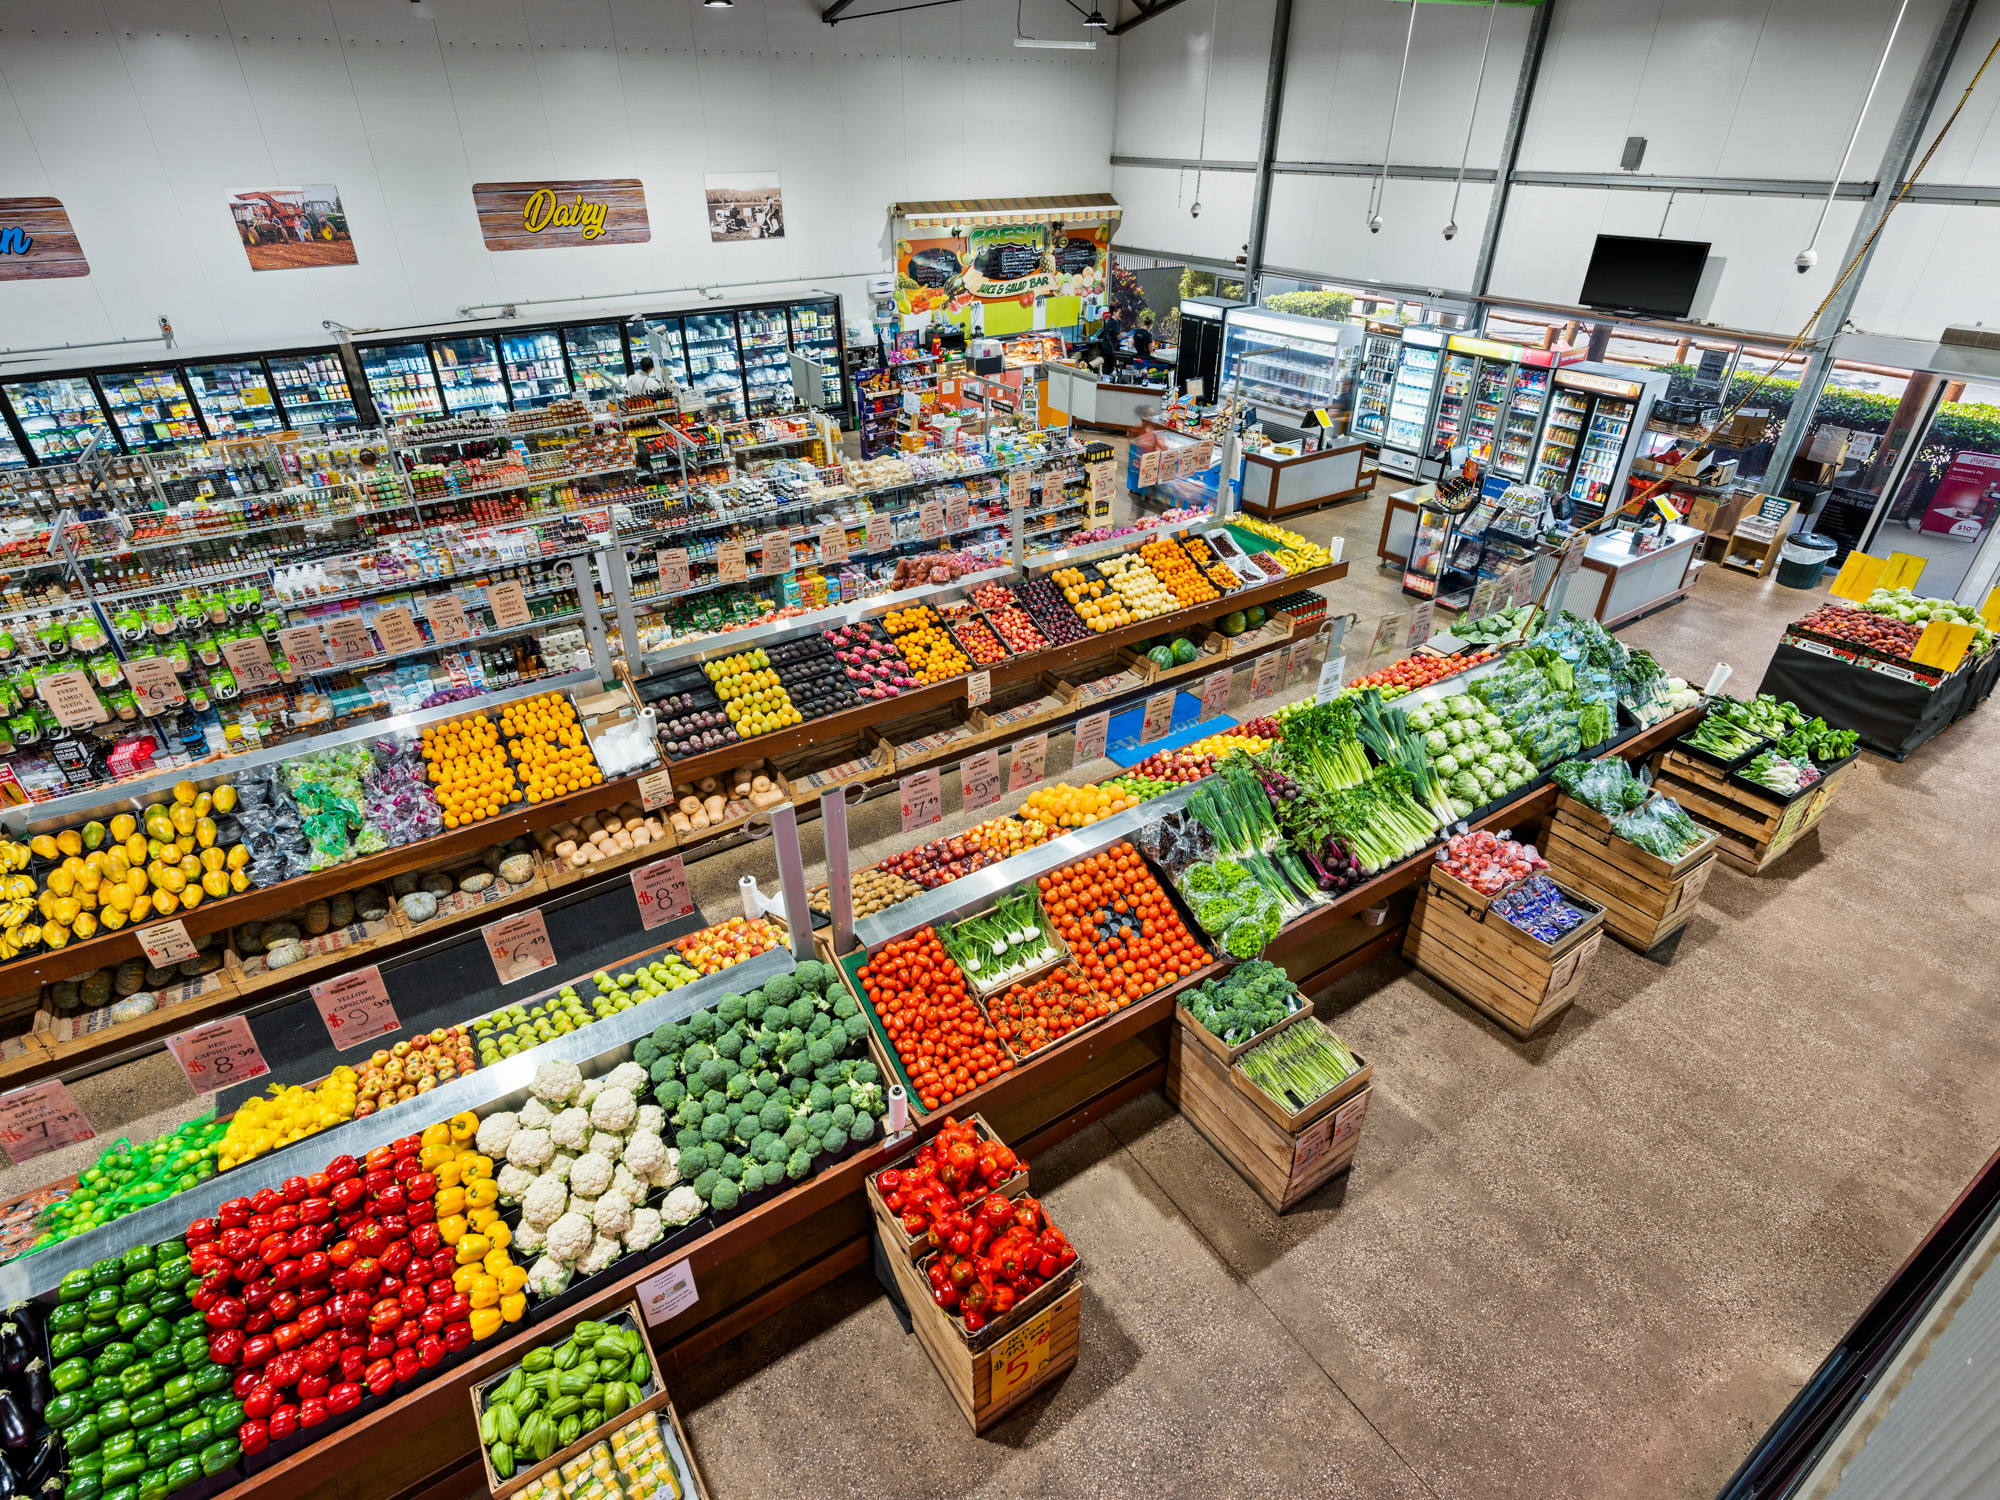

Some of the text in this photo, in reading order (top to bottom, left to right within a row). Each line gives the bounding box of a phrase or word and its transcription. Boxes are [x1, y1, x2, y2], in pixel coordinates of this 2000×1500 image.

[524, 189, 607, 240] Dairy
[970, 224, 1043, 255] FRESH
[976, 276, 1049, 295] JUICE & SALAD BAR
[1970, 457, 1998, 466] Coca-Cola
[1830, 494, 1855, 506] Black
[1900, 472, 1926, 518] CONNOISSEUR
[387, 626, 406, 634] FAMILY
[391, 637, 413, 646] FARMER
[57, 686, 78, 695] EVERY
[59, 693, 84, 702] FAMILY
[60, 701, 82, 709] NEEDS
[65, 706, 93, 716] FARMER
[1084, 726, 1102, 734] GOURMET
[1082, 732, 1102, 740] TOMATOES
[55, 752, 80, 761] SHAKE
[969, 773, 992, 784] TOMATOES
[909, 792, 933, 802] TOMATOES
[646, 876, 674, 889] BROCCOLI
[153, 938, 180, 948] PUMPKINS
[494, 928, 541, 947] CAULIFLOWER
[347, 980, 366, 989] Market
[337, 989, 368, 1003] YELLOW
[334, 995, 375, 1012] CAPSICUMS
[192, 1035, 208, 1044] Farm
[210, 1029, 232, 1038] Market
[208, 1041, 225, 1049] RED
[195, 1043, 242, 1060] CAPSICUMS
[0, 1104, 19, 1112] Farm
[21, 1095, 47, 1106] Market
[15, 1104, 47, 1118] GREEN
[8, 1109, 61, 1128] CAPSICUMS
